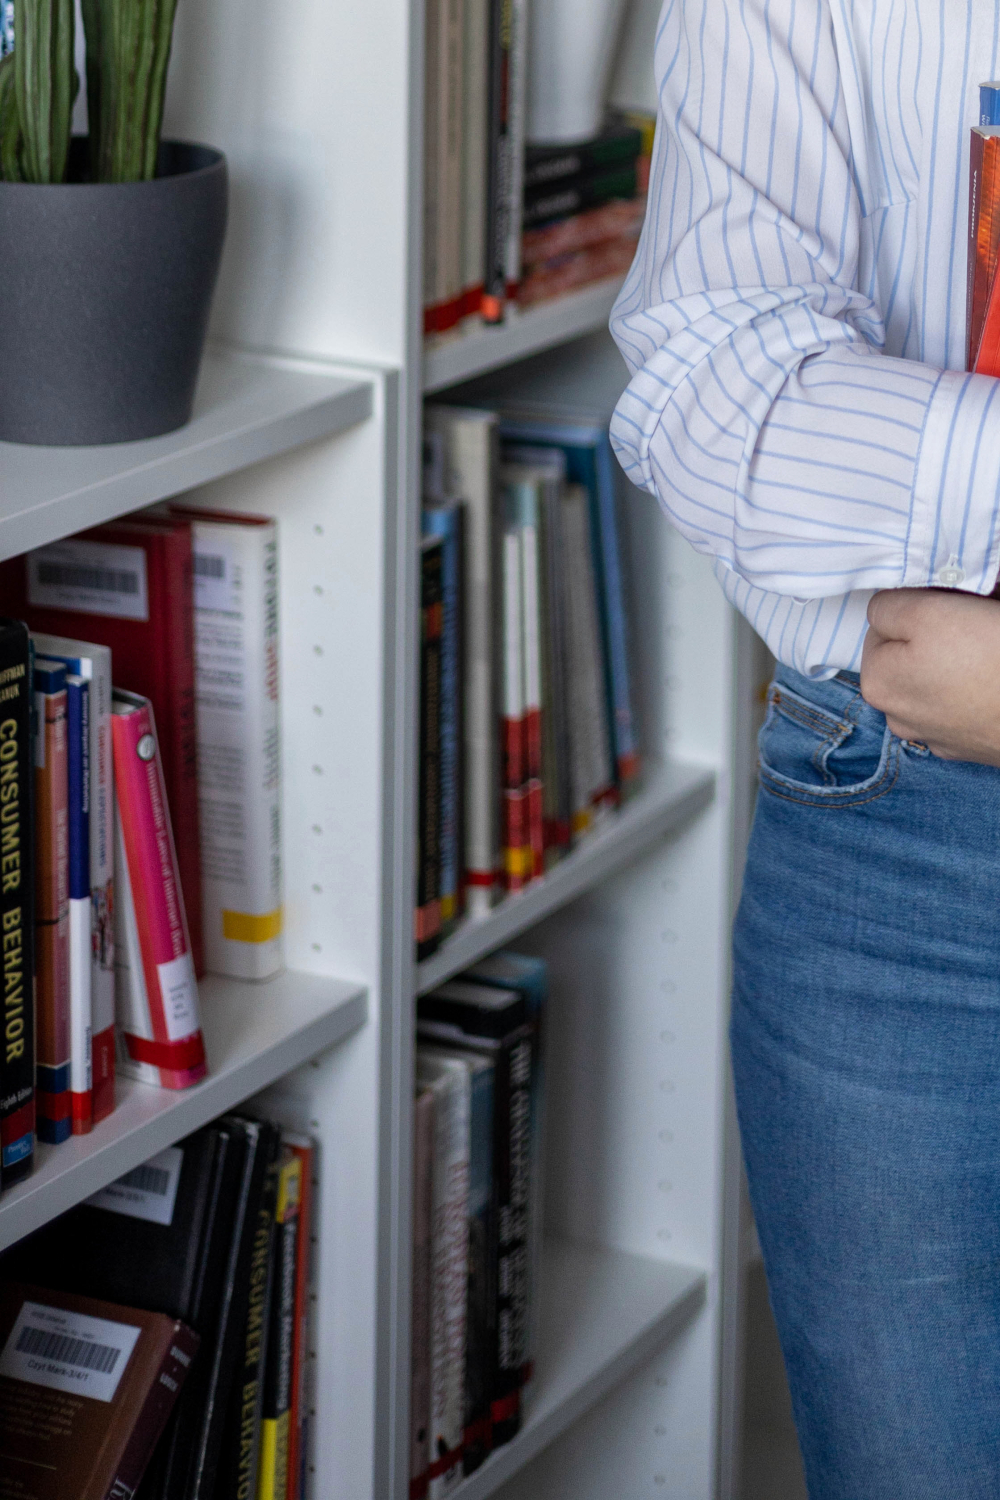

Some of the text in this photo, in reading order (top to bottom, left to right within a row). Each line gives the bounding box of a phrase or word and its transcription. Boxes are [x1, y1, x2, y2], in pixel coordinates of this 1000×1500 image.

[0, 718, 25, 1064] CONSUMER BEHAVIOR
[236, 1380, 259, 1500] BEHAVIO
